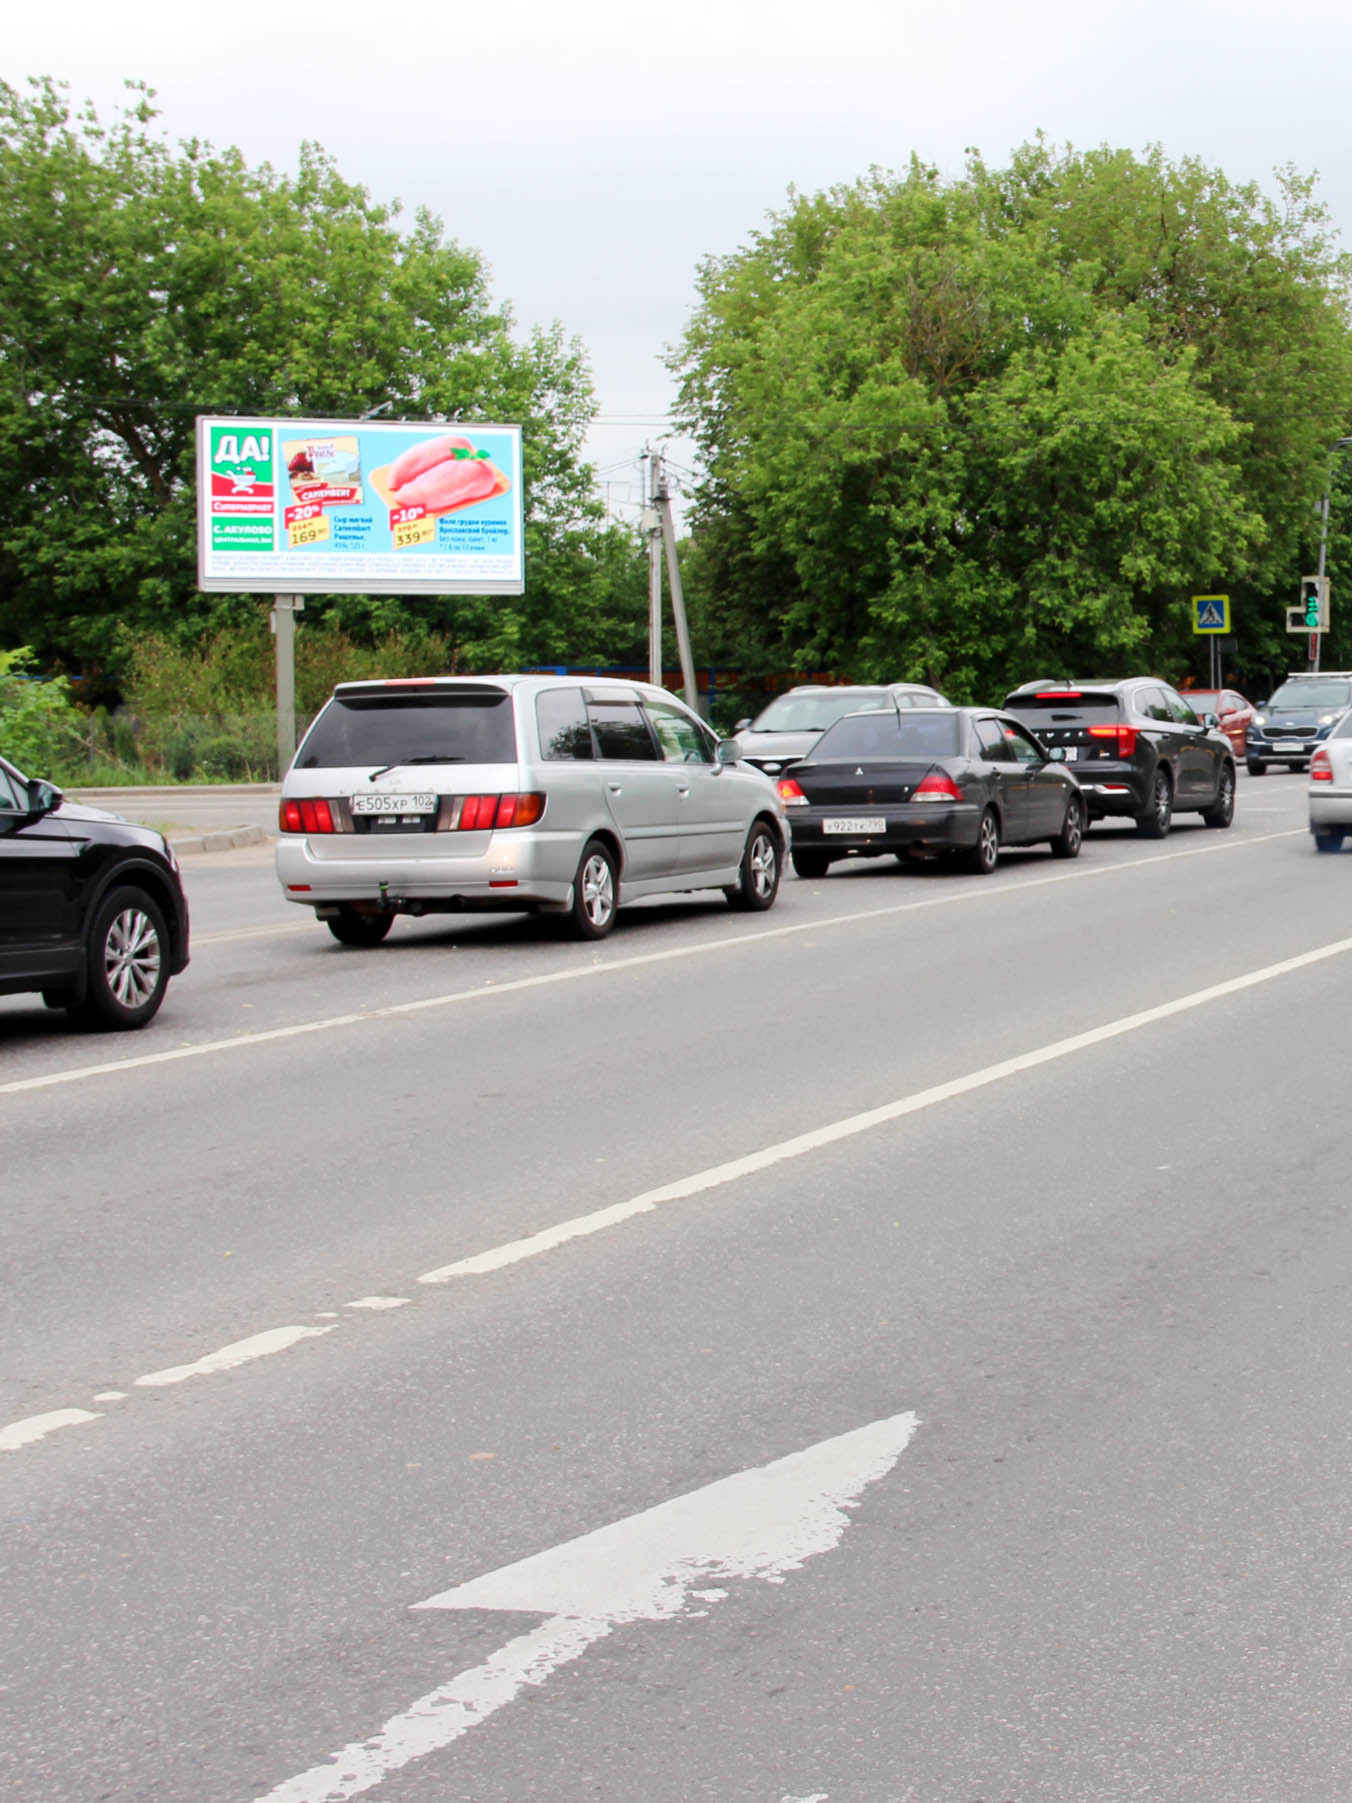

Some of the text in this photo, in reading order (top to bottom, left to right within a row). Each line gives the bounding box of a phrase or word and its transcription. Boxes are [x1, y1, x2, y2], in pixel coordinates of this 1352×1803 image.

[214, 435, 270, 464] ДА!
[292, 529, 317, 545] 169
[396, 531, 421, 547] 339
